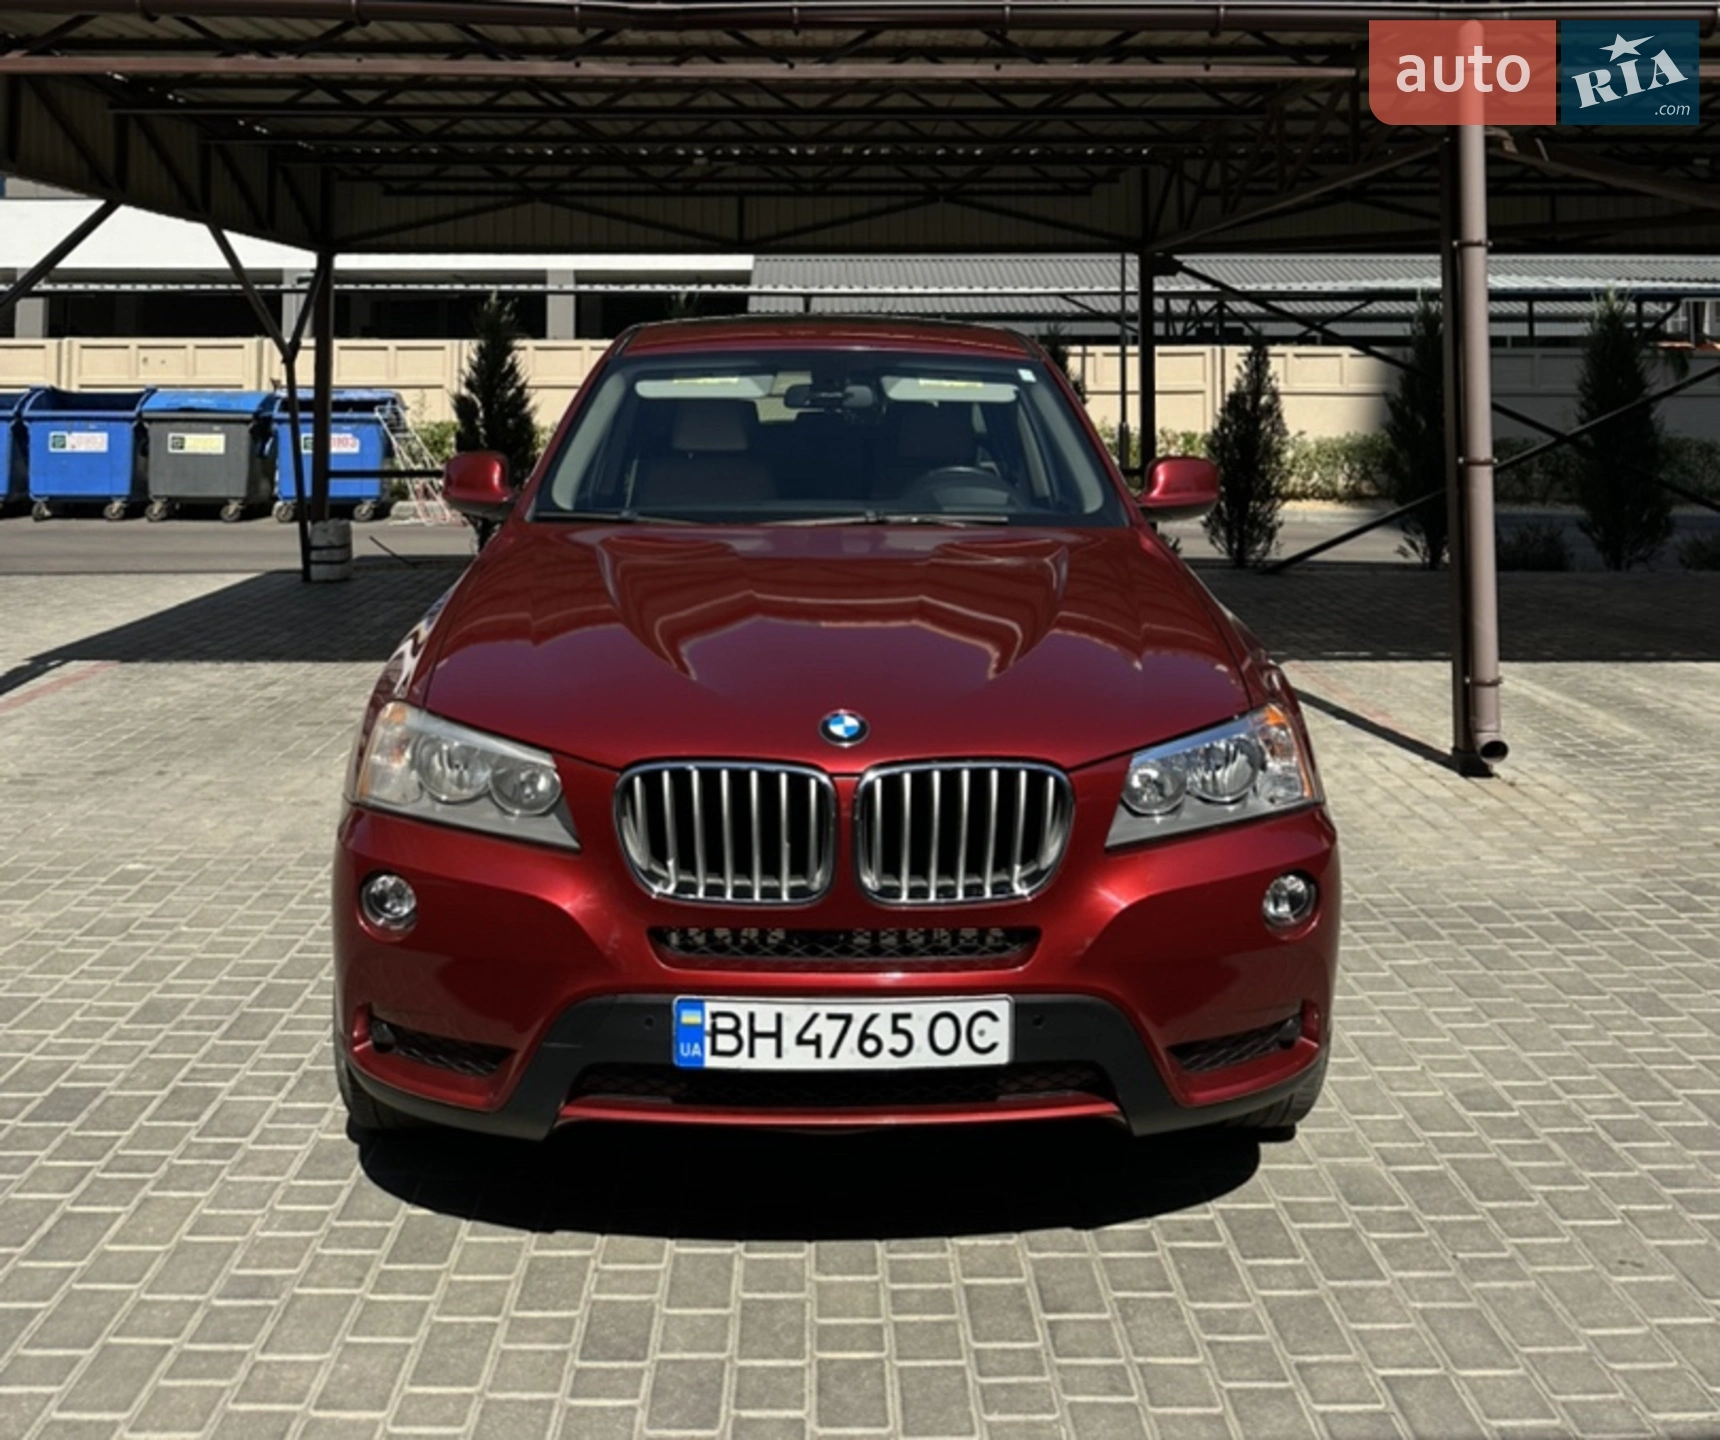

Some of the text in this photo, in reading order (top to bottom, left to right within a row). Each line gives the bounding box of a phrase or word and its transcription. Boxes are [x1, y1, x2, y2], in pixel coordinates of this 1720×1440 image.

[680, 1042, 703, 1058] UA
[709, 1009, 1000, 1060] BH 4765 OC
